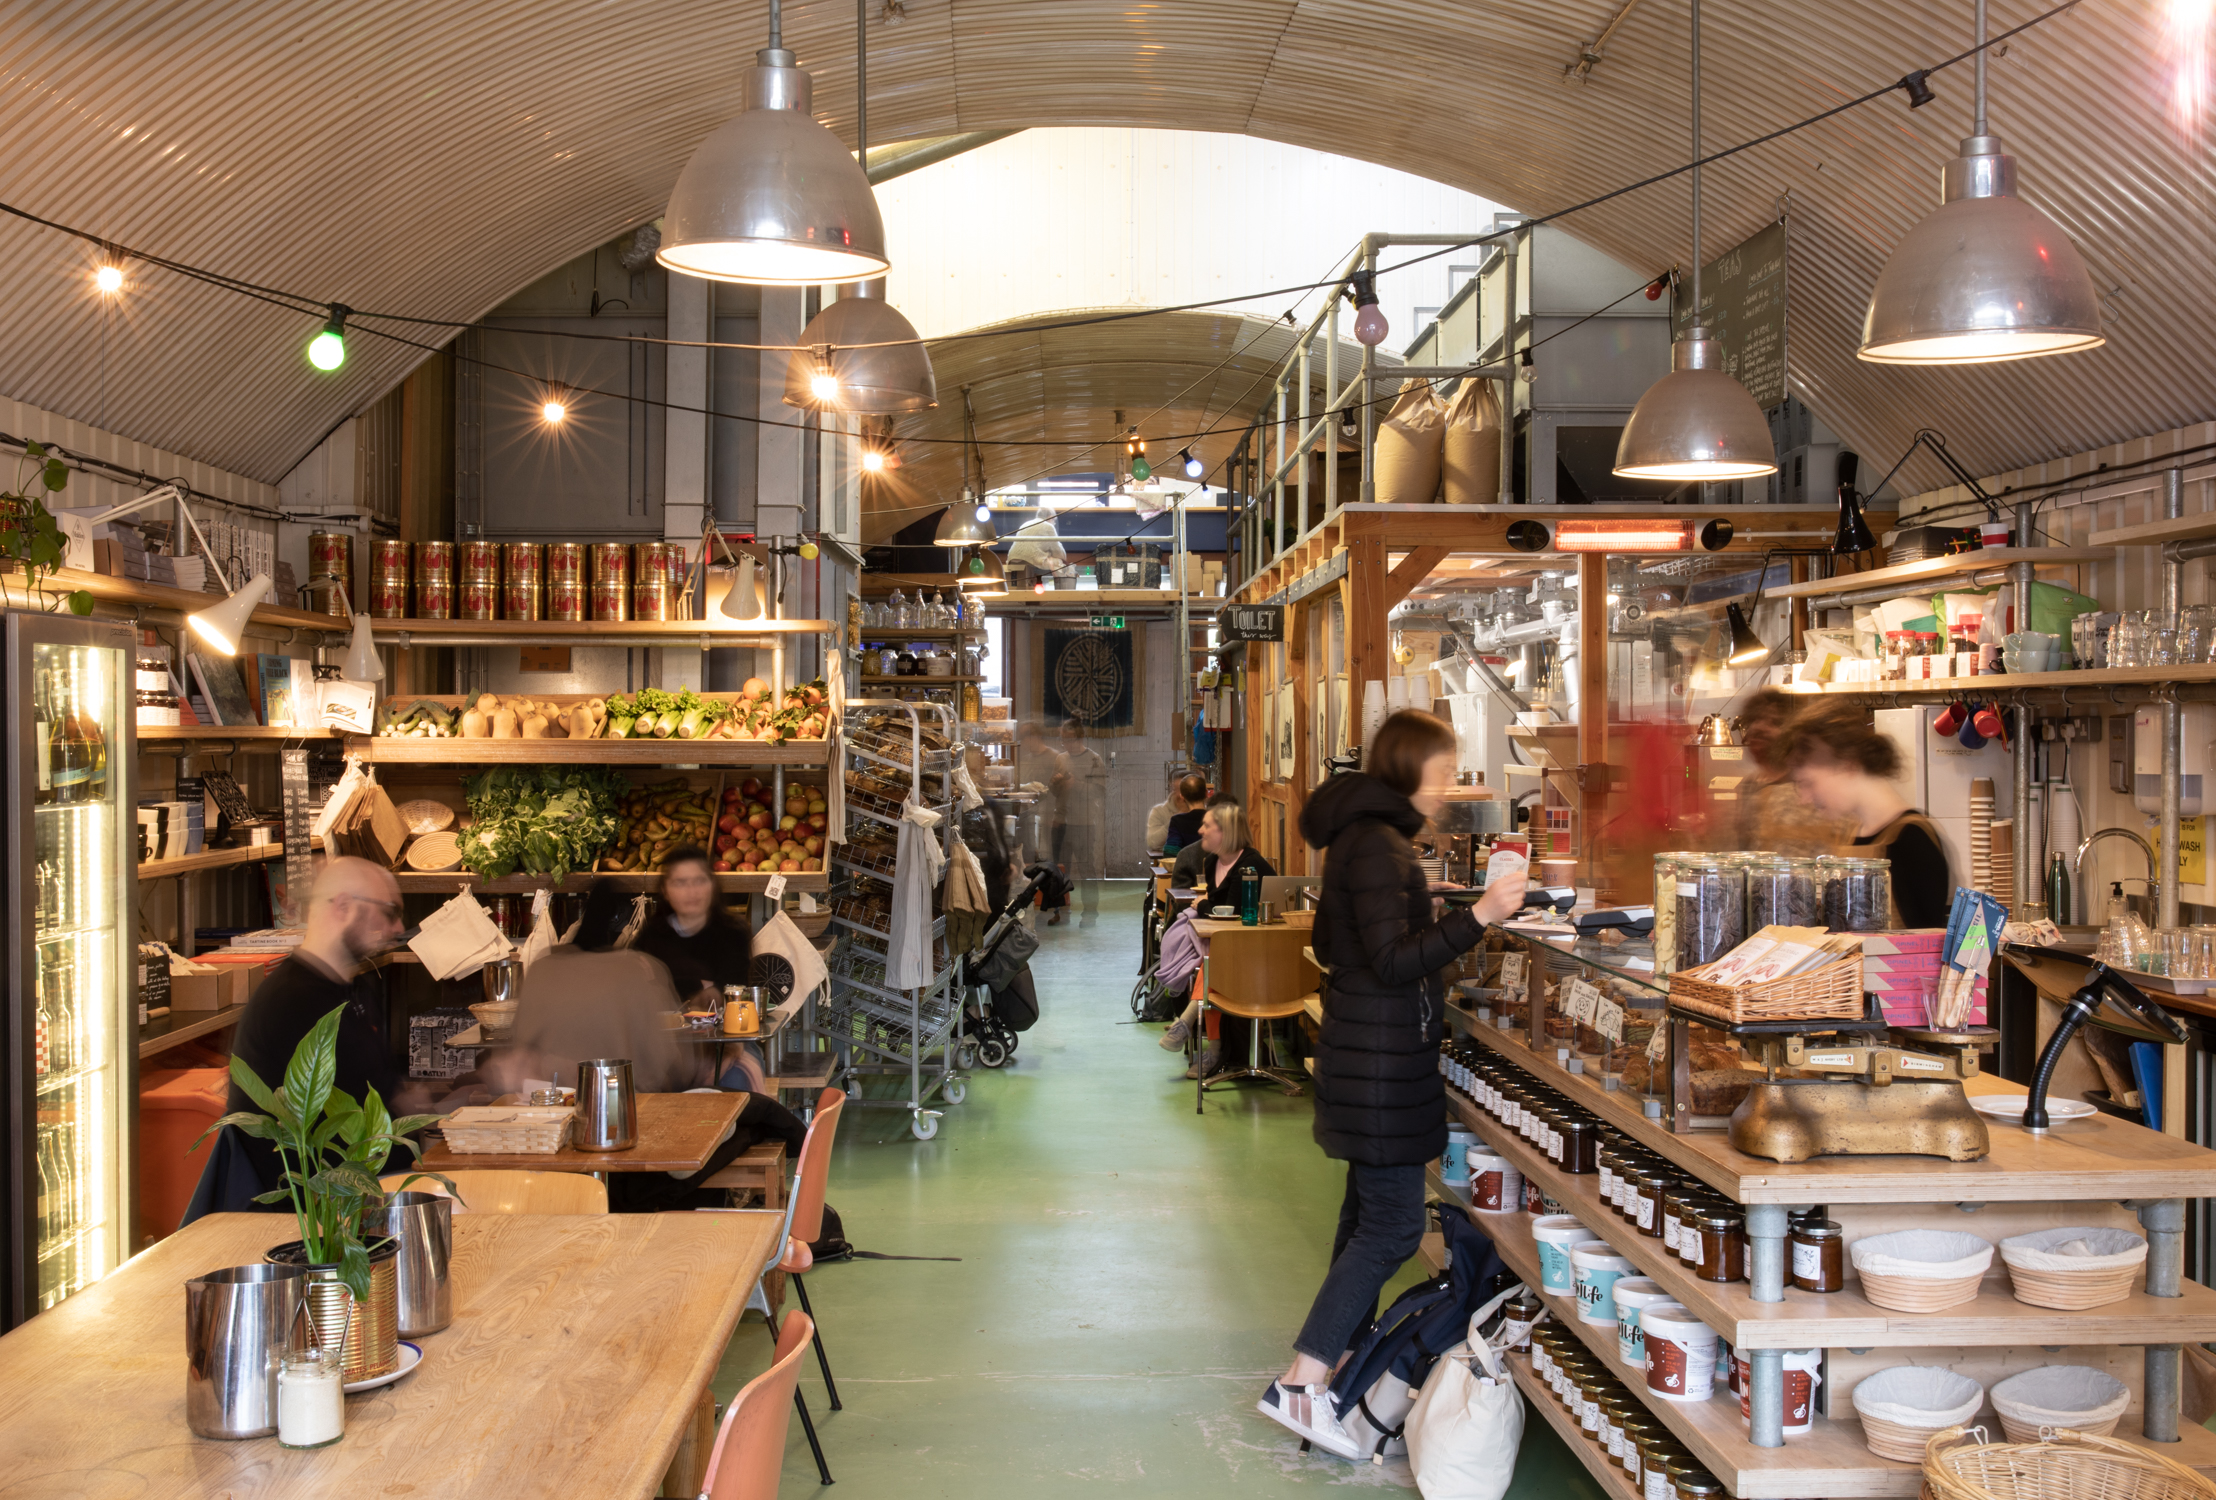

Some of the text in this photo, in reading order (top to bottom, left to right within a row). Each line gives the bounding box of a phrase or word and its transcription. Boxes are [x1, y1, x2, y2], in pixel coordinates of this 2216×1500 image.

[1718, 249, 1742, 284] TEAS
[1227, 606, 1275, 630] TOILET
[110, 628, 133, 636] precision
[1241, 631, 1277, 640] this way
[2179, 840, 2201, 852] WASH
[344, 1365, 367, 1376] MATES
